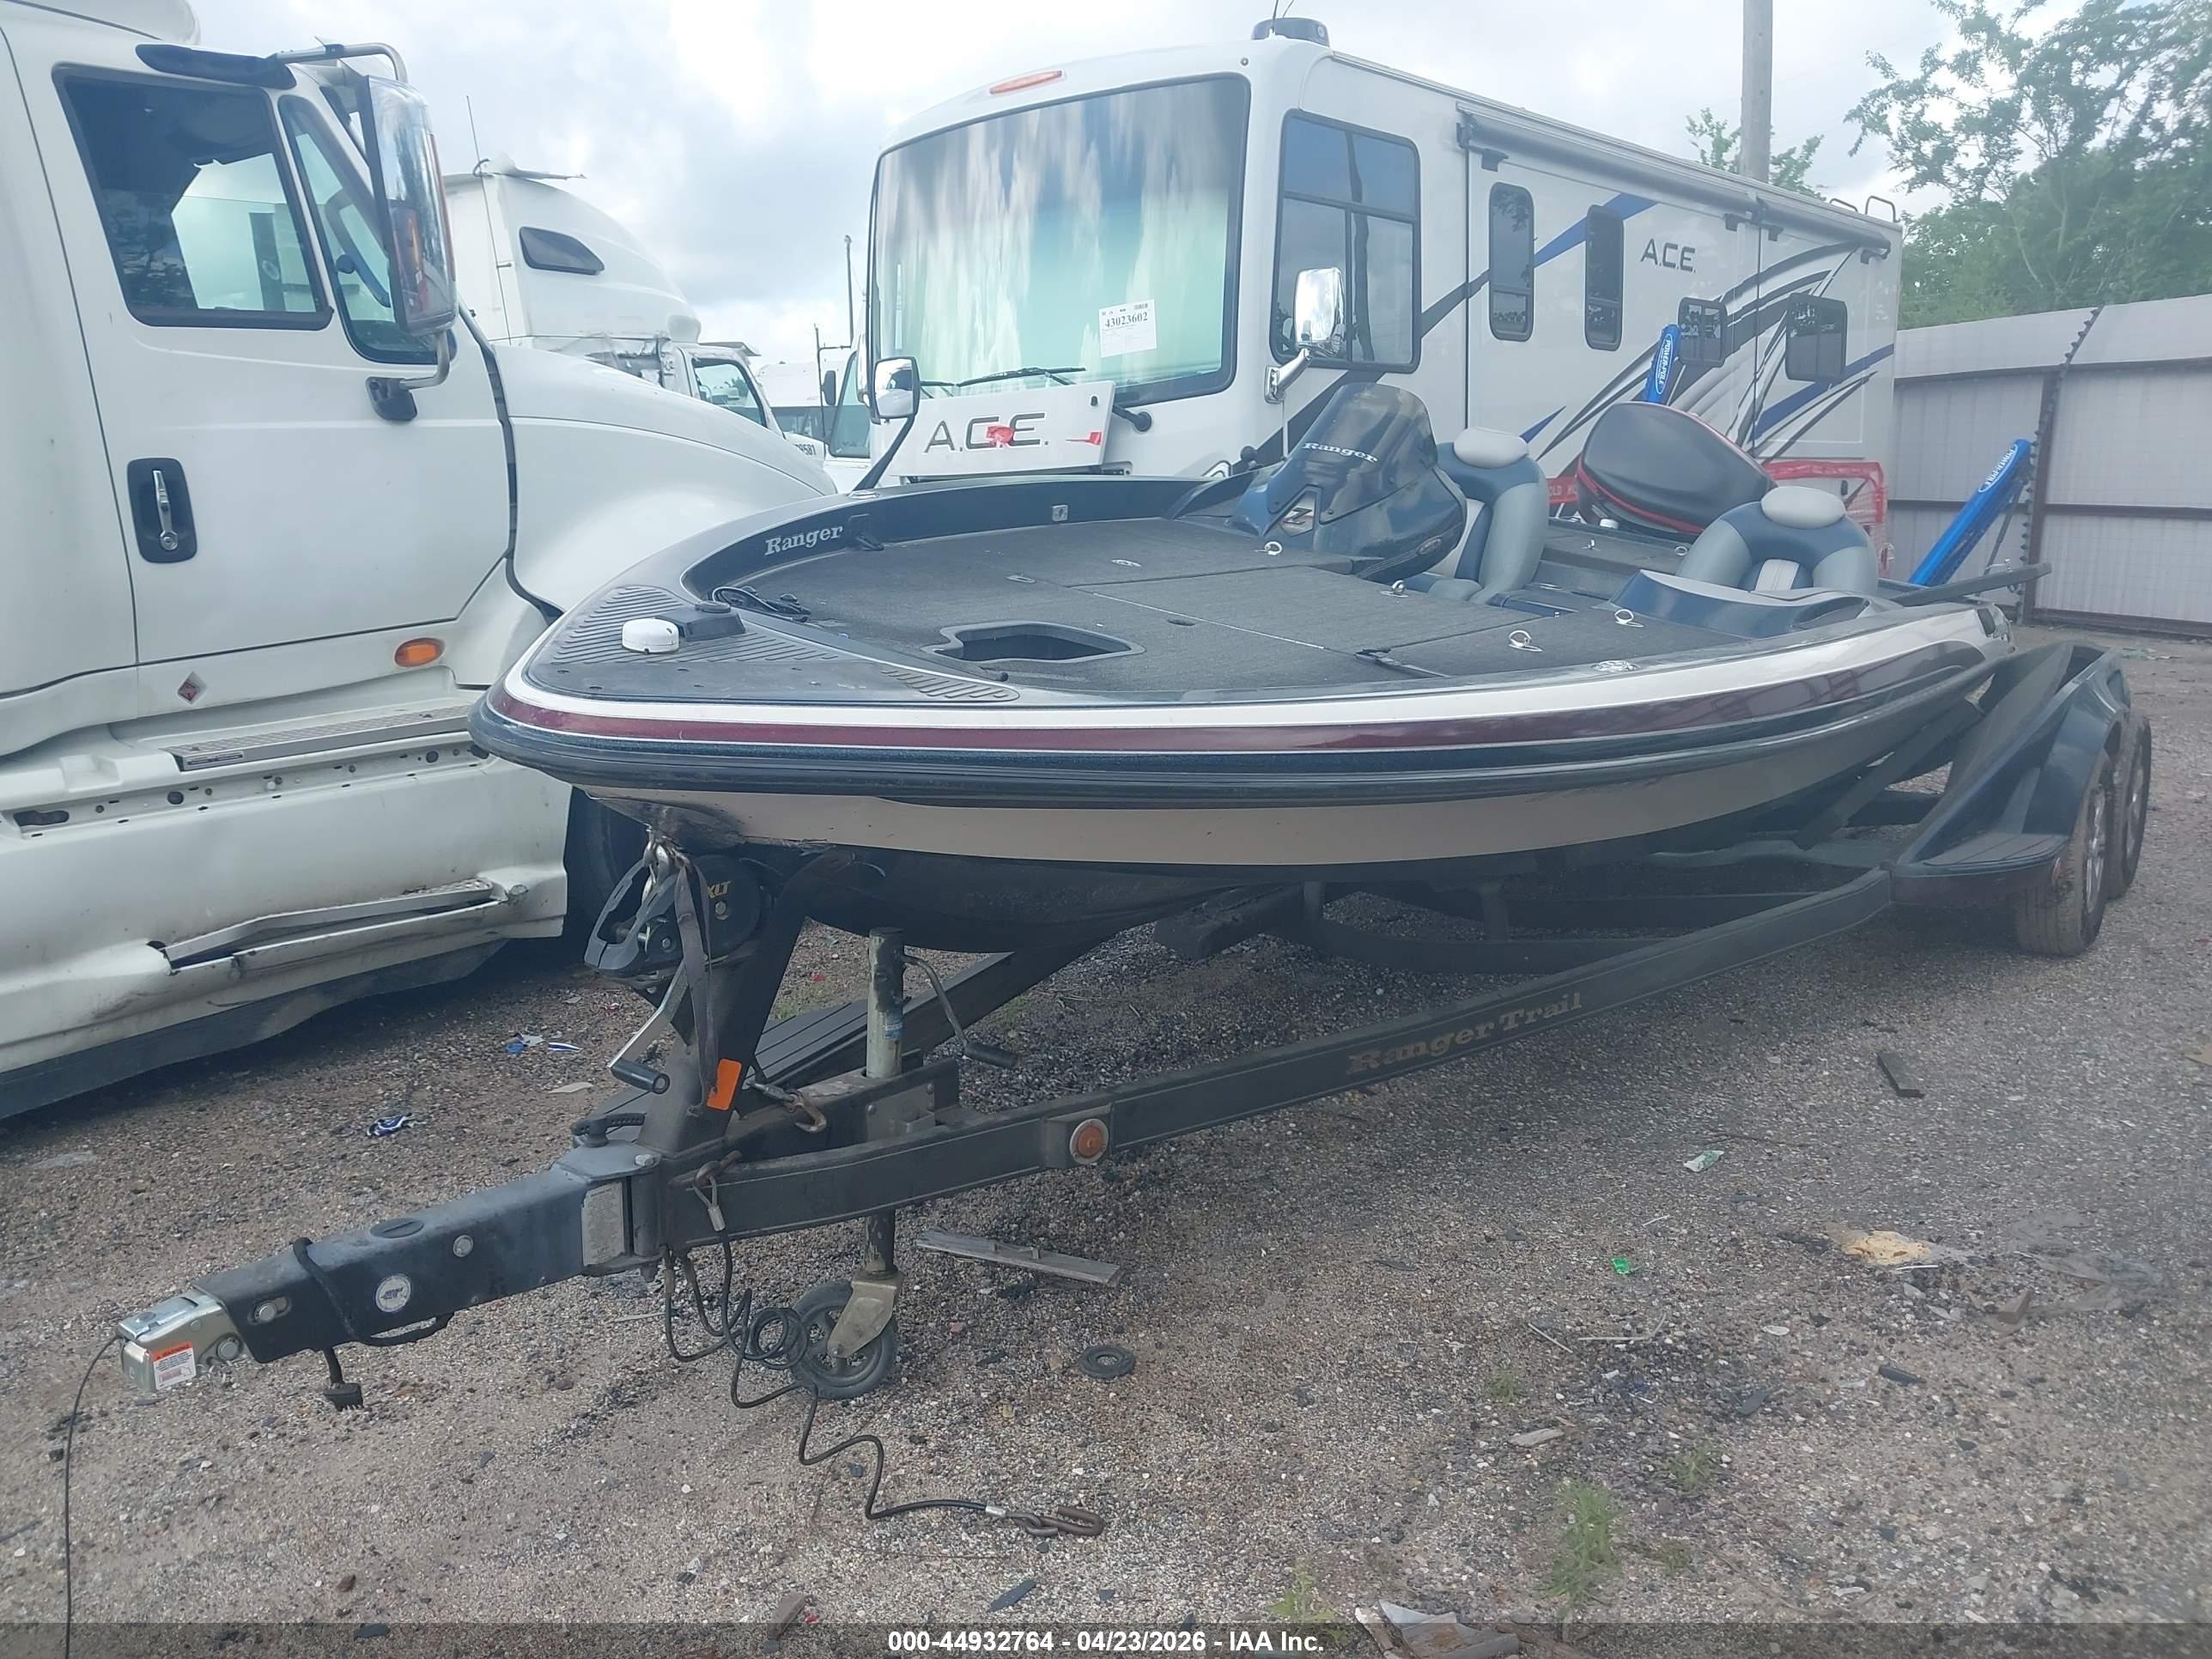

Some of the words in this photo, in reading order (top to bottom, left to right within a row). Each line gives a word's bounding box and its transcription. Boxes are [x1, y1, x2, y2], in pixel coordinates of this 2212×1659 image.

[1104, 311, 1148, 328] 43023602
[1658, 339, 1671, 386] POWER-POLE
[1302, 442, 1378, 463] Ranger
[764, 526, 843, 556] Ranger
